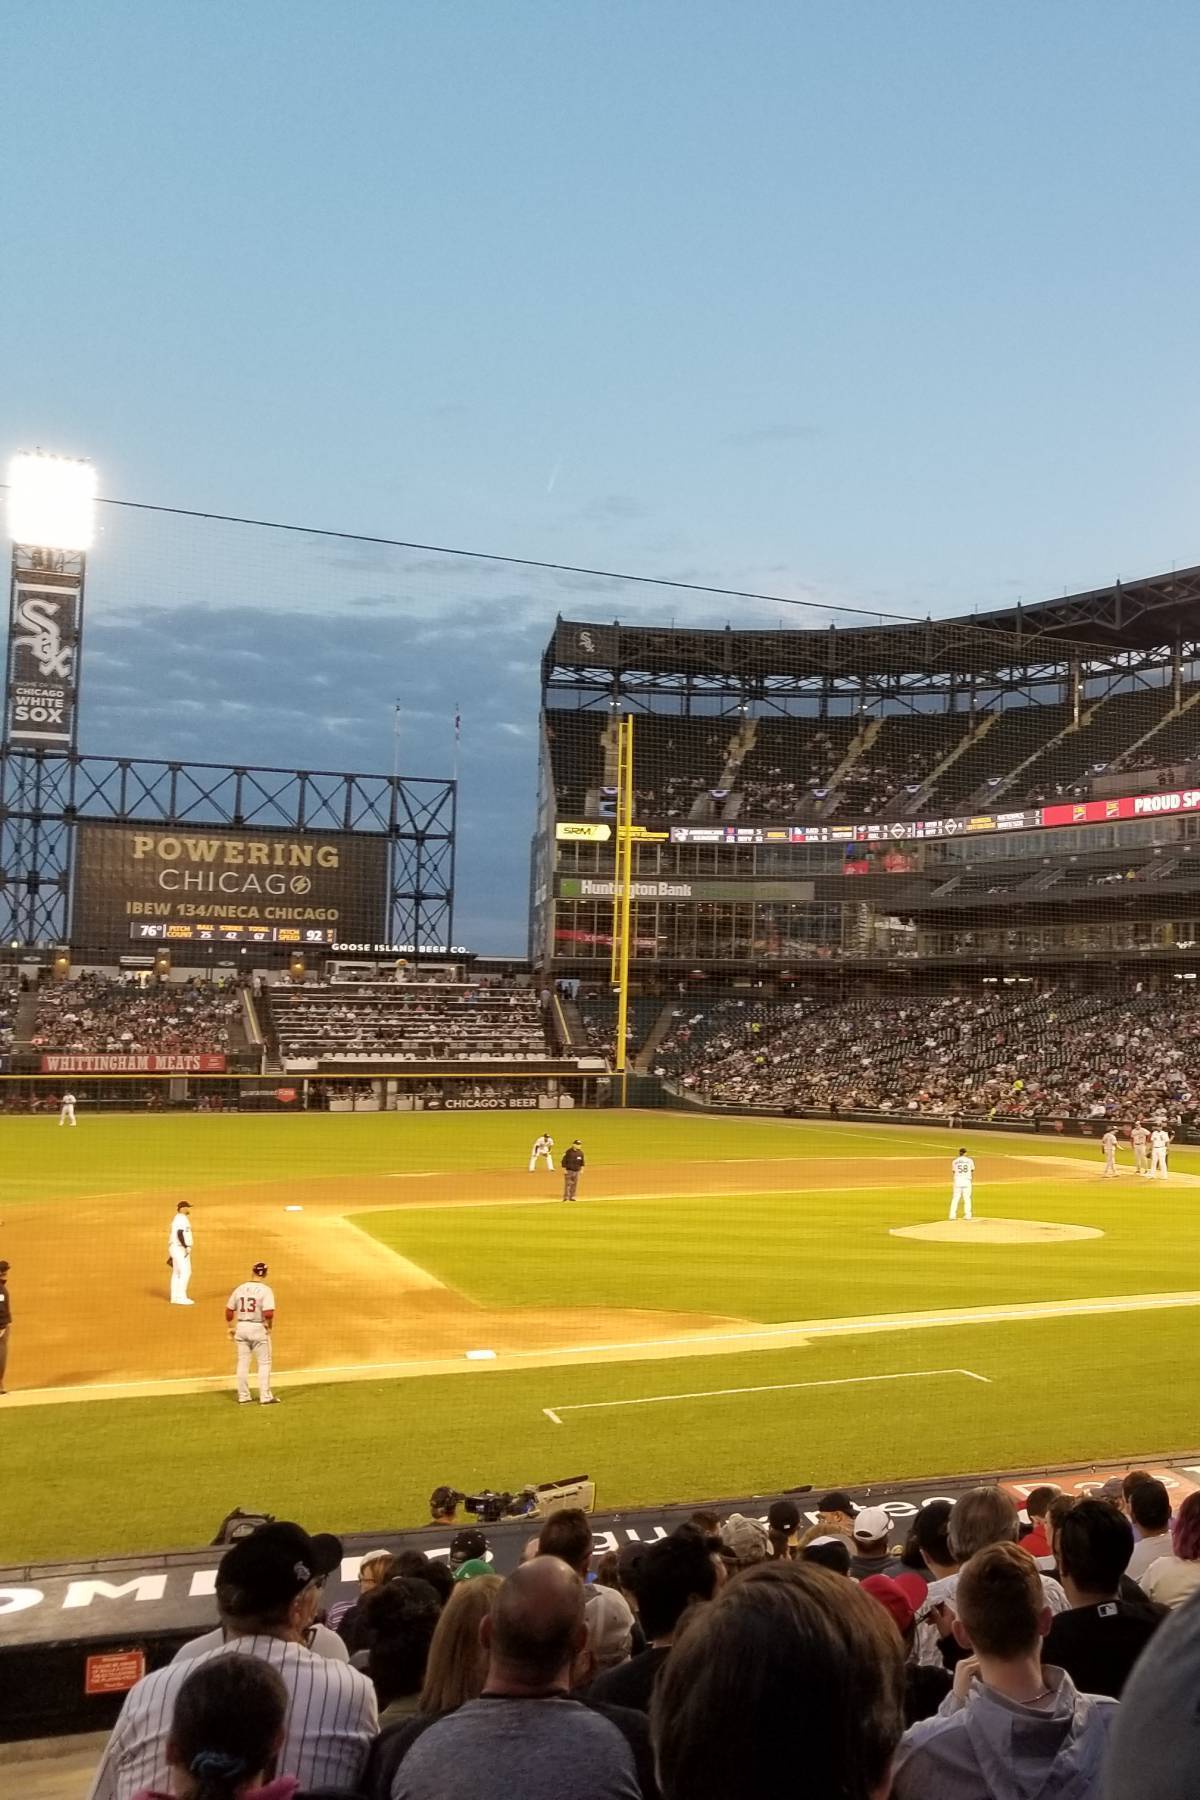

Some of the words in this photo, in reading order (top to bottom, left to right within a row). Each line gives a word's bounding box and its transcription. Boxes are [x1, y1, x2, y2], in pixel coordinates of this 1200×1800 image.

[16, 687, 64, 698] CHICAGO
[15, 696, 64, 708] WHITE
[14, 706, 63, 724] SOX
[1134, 797, 1181, 814] PROUD
[133, 836, 339, 868] POWERING
[159, 869, 311, 895] CHICAGO
[658, 881, 692, 897] Bank
[126, 901, 171, 916] IBEW
[176, 903, 260, 919] 134/NECA
[264, 906, 339, 921] CHICAGO
[140, 925, 162, 937] 76°
[306, 930, 323, 941] 92
[331, 943, 370, 952] GOOSE
[374, 944, 416, 953] ISLAND
[419, 945, 447, 953] BEER
[450, 946, 471, 954] CO.
[47, 1055, 150, 1071] WHITTINGHAM
[155, 1055, 201, 1071] MEATS
[445, 1097, 507, 1110] CHICAGO'S
[509, 1097, 537, 1109] BEER
[239, 1296, 257, 1313] 13
